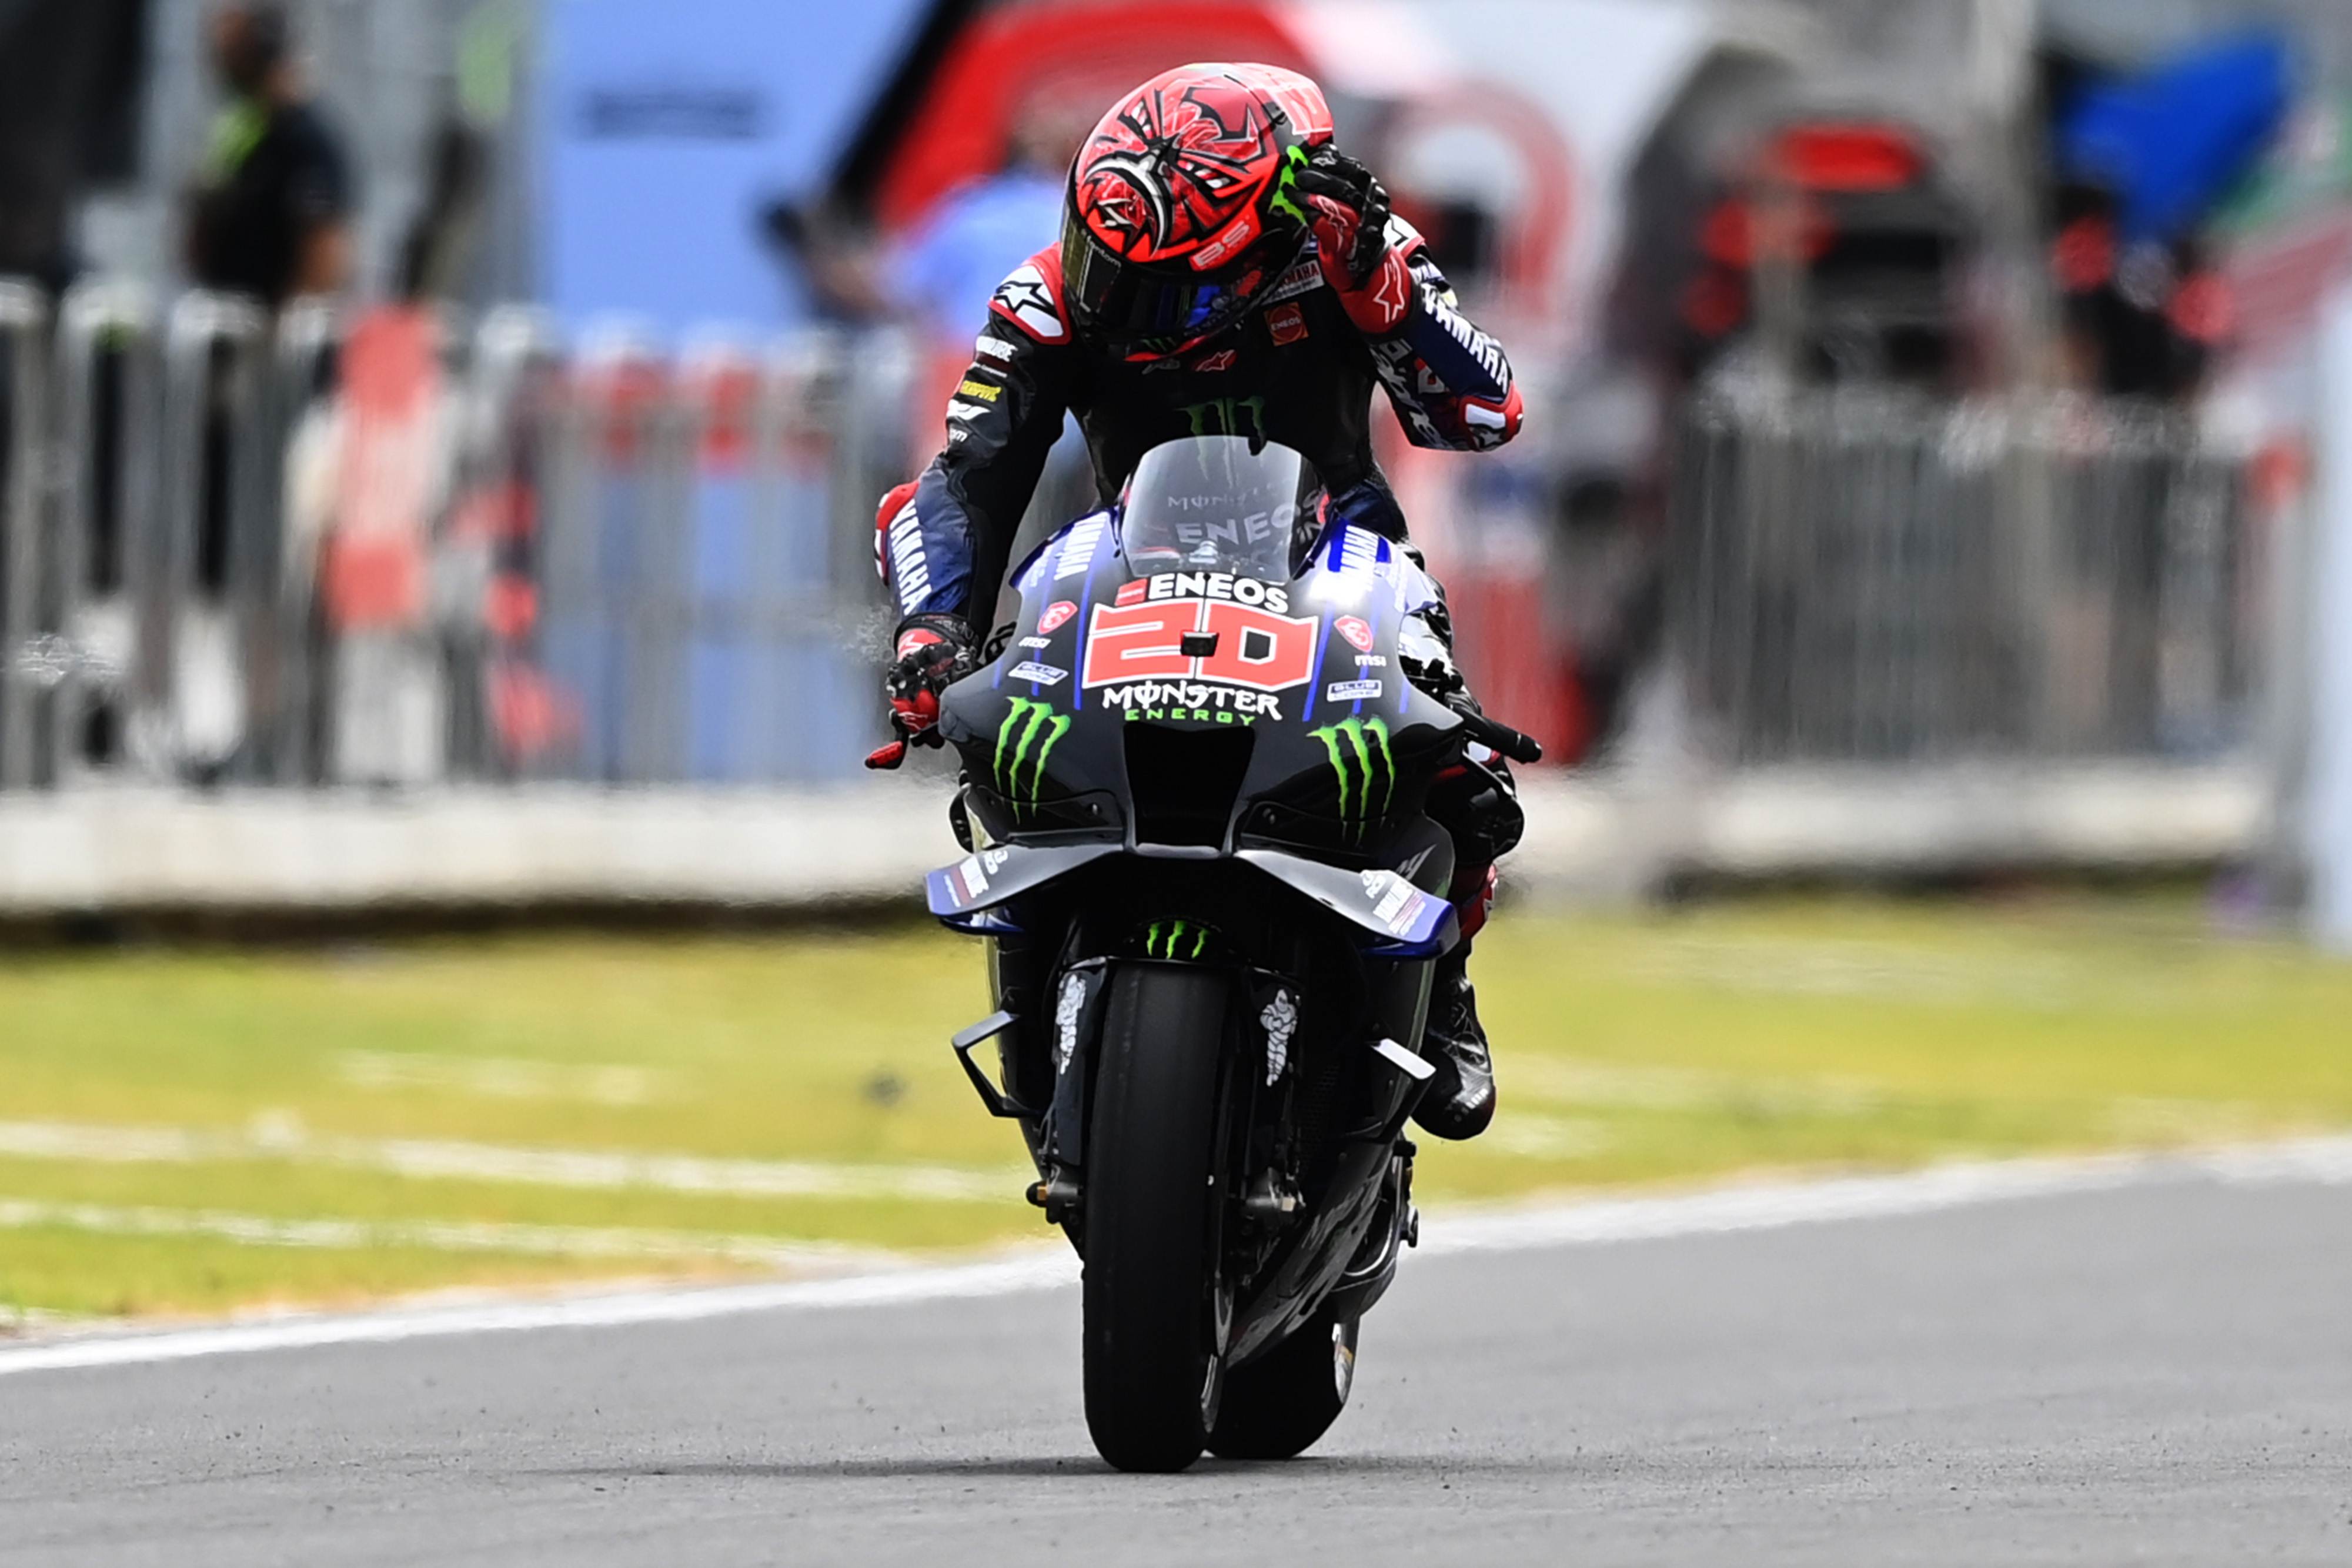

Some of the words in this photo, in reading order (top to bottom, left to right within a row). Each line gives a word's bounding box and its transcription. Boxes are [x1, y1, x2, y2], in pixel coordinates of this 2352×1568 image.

[1271, 317, 1301, 330] ENEOS
[1421, 283, 1509, 395] YAMAHA
[1175, 501, 1302, 545] ENEO
[890, 499, 932, 616] YAMAHA
[1054, 511, 1109, 581] YAMAHA
[1148, 571, 1289, 614] ENEOS
[1082, 597, 1319, 692] 20
[1102, 680, 1282, 721] MONSTER
[1125, 708, 1256, 726] ENERGY
